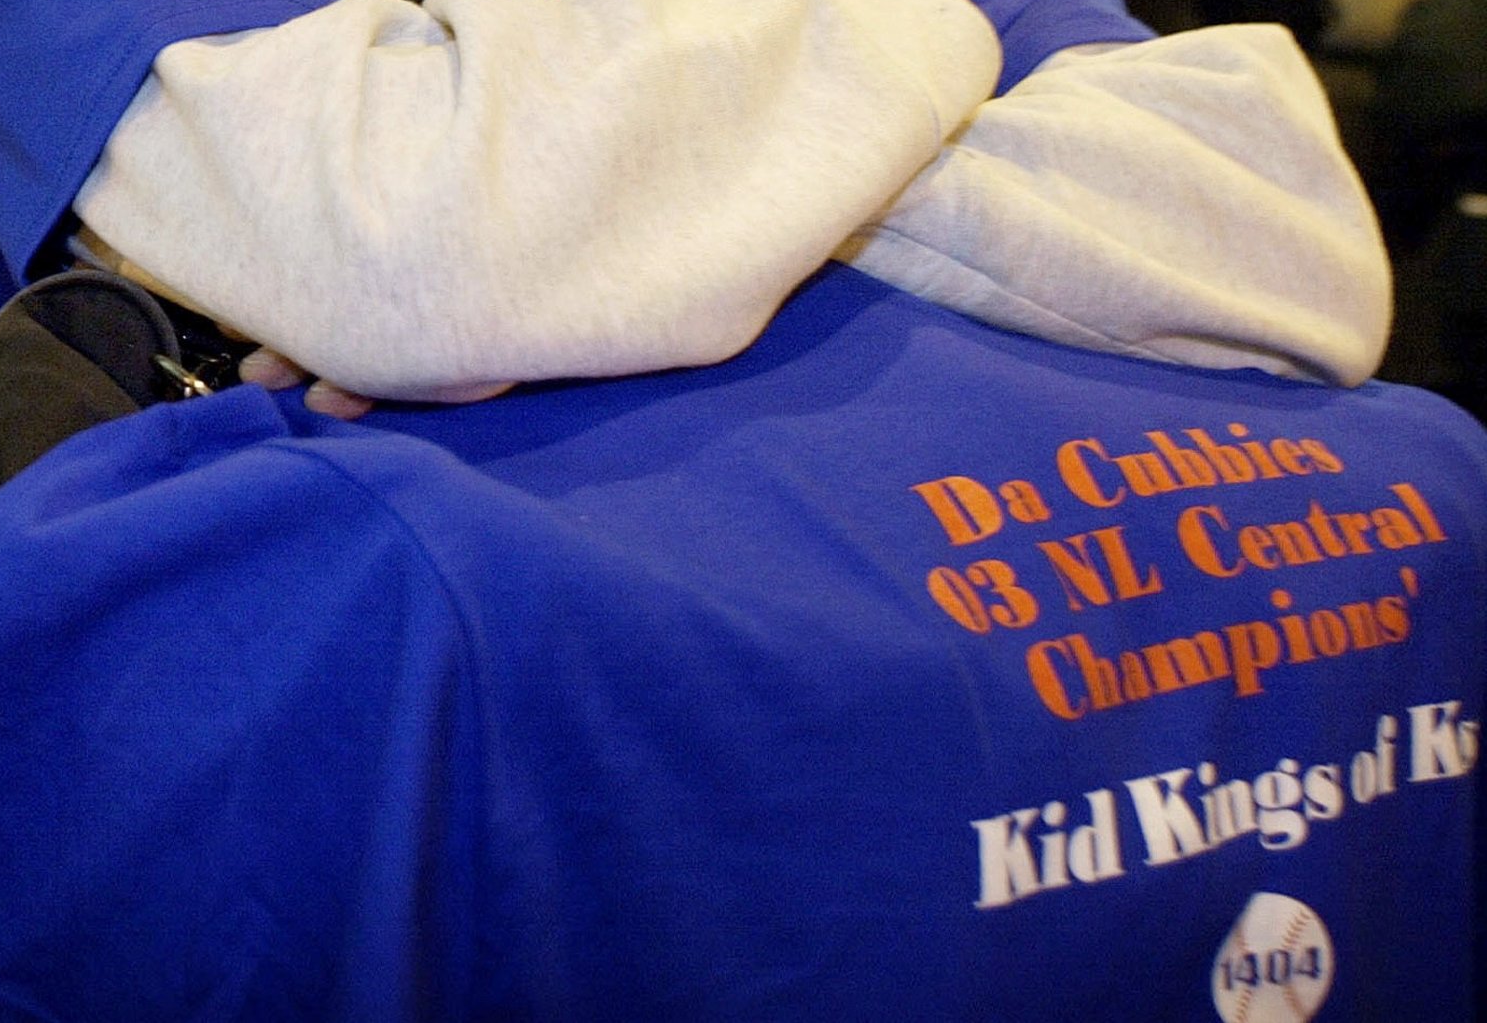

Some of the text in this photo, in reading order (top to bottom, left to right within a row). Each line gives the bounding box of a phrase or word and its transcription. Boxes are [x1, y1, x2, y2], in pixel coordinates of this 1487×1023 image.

[910, 422, 1345, 546] Da Cubbies
[926, 482, 1448, 635] 03 NL Central
[1025, 566, 1420, 721] Champions'
[970, 800, 1126, 910] Kid
[1124, 758, 1344, 867] Kings
[1351, 713, 1398, 804] of
[1220, 946, 1320, 991] 1404
